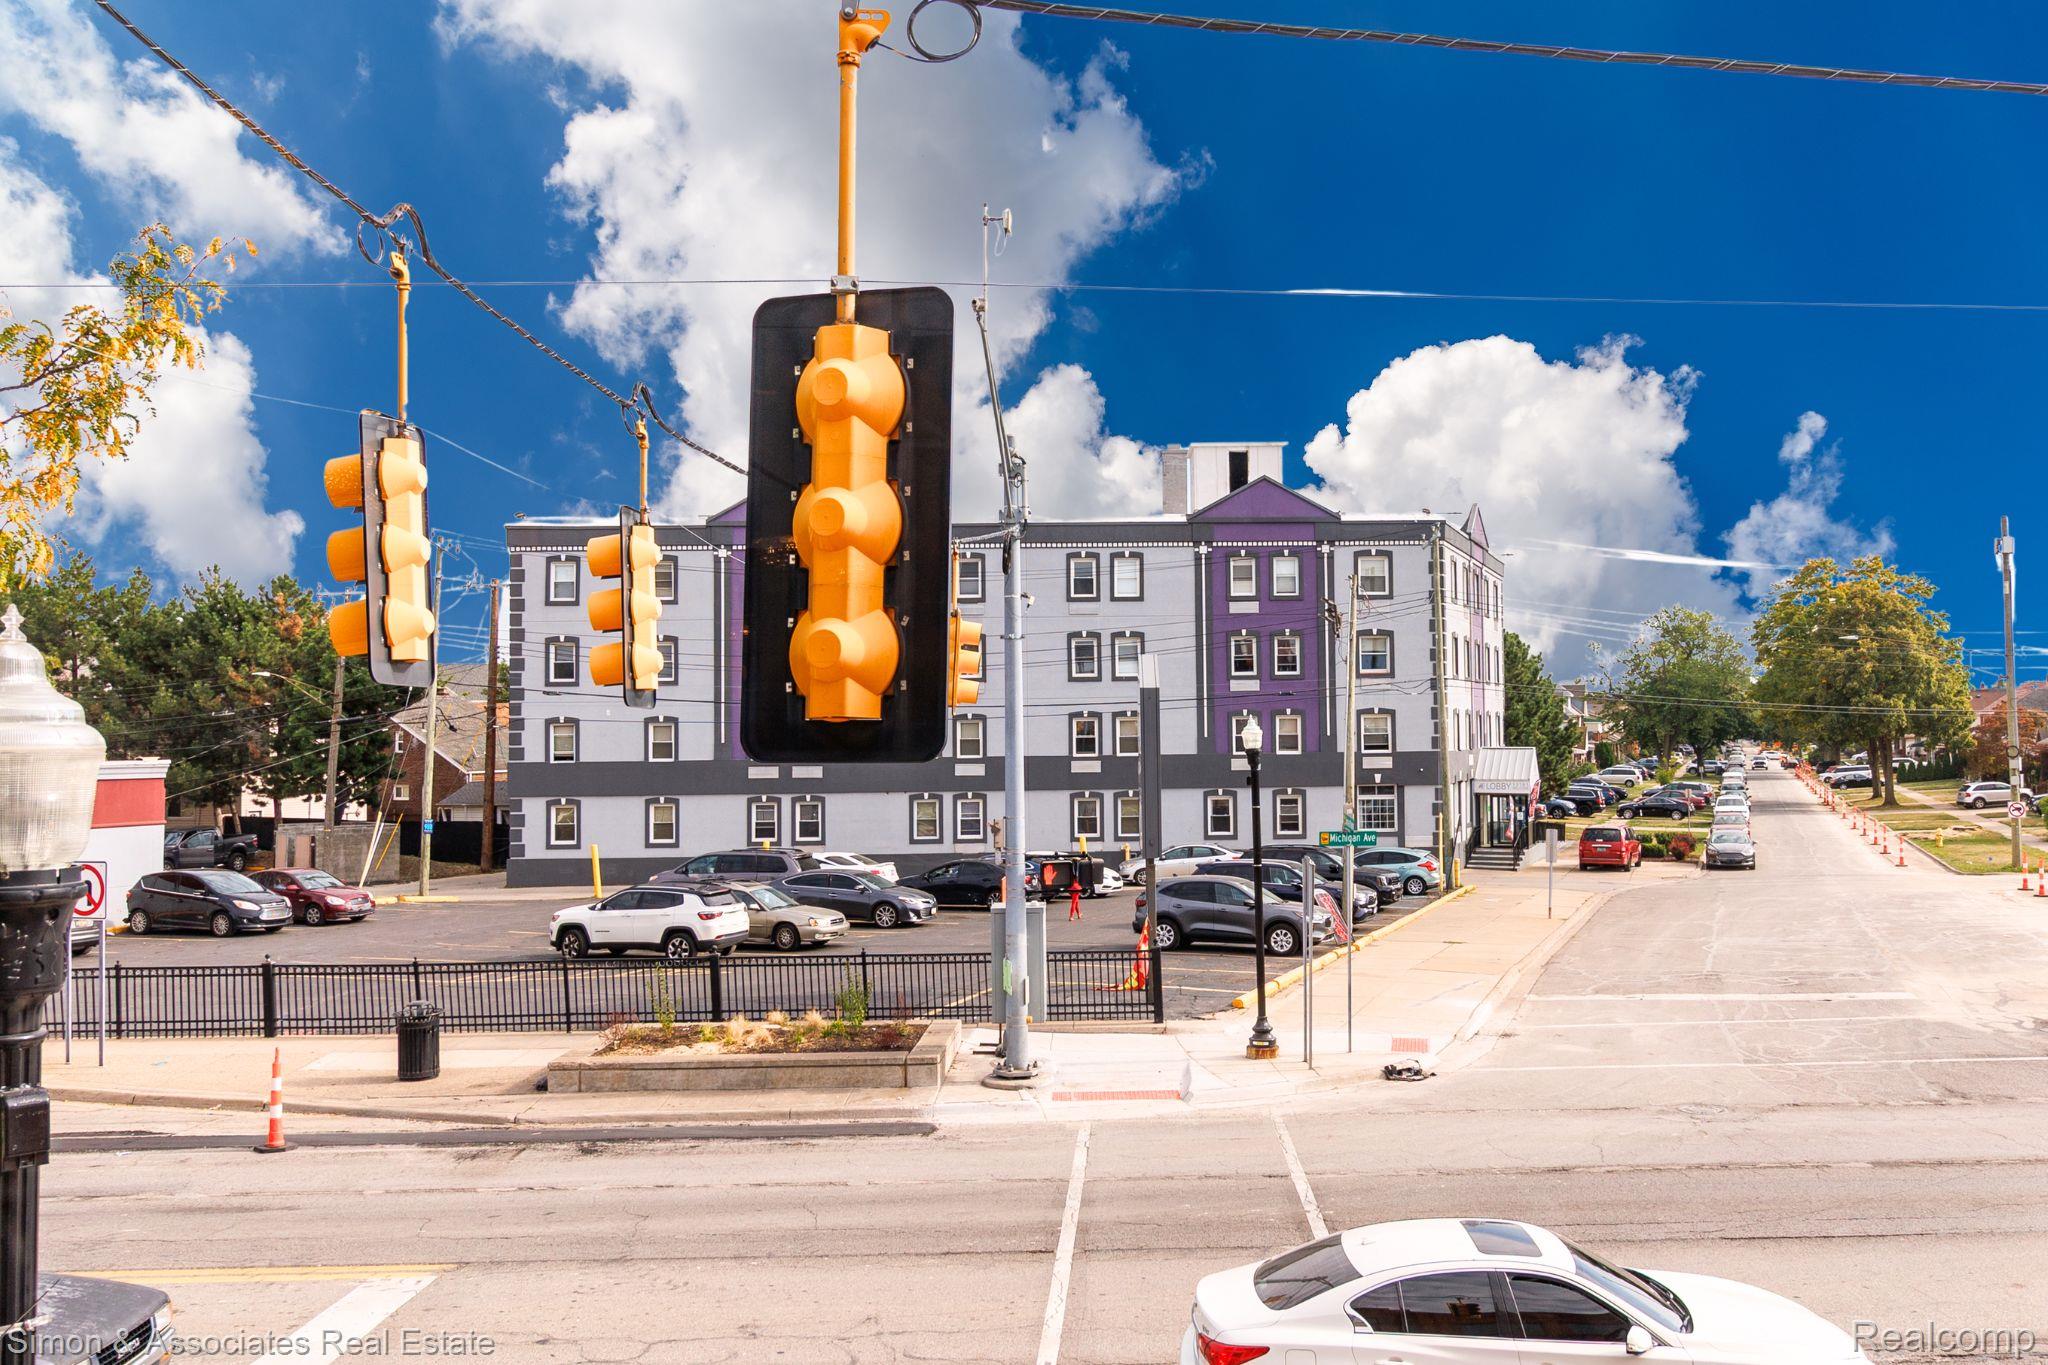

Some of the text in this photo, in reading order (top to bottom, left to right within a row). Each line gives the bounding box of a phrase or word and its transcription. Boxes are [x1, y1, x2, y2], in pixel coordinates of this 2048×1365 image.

[1486, 782, 1511, 790] LOBBY
[1330, 833, 1376, 846] Michigan Ave
